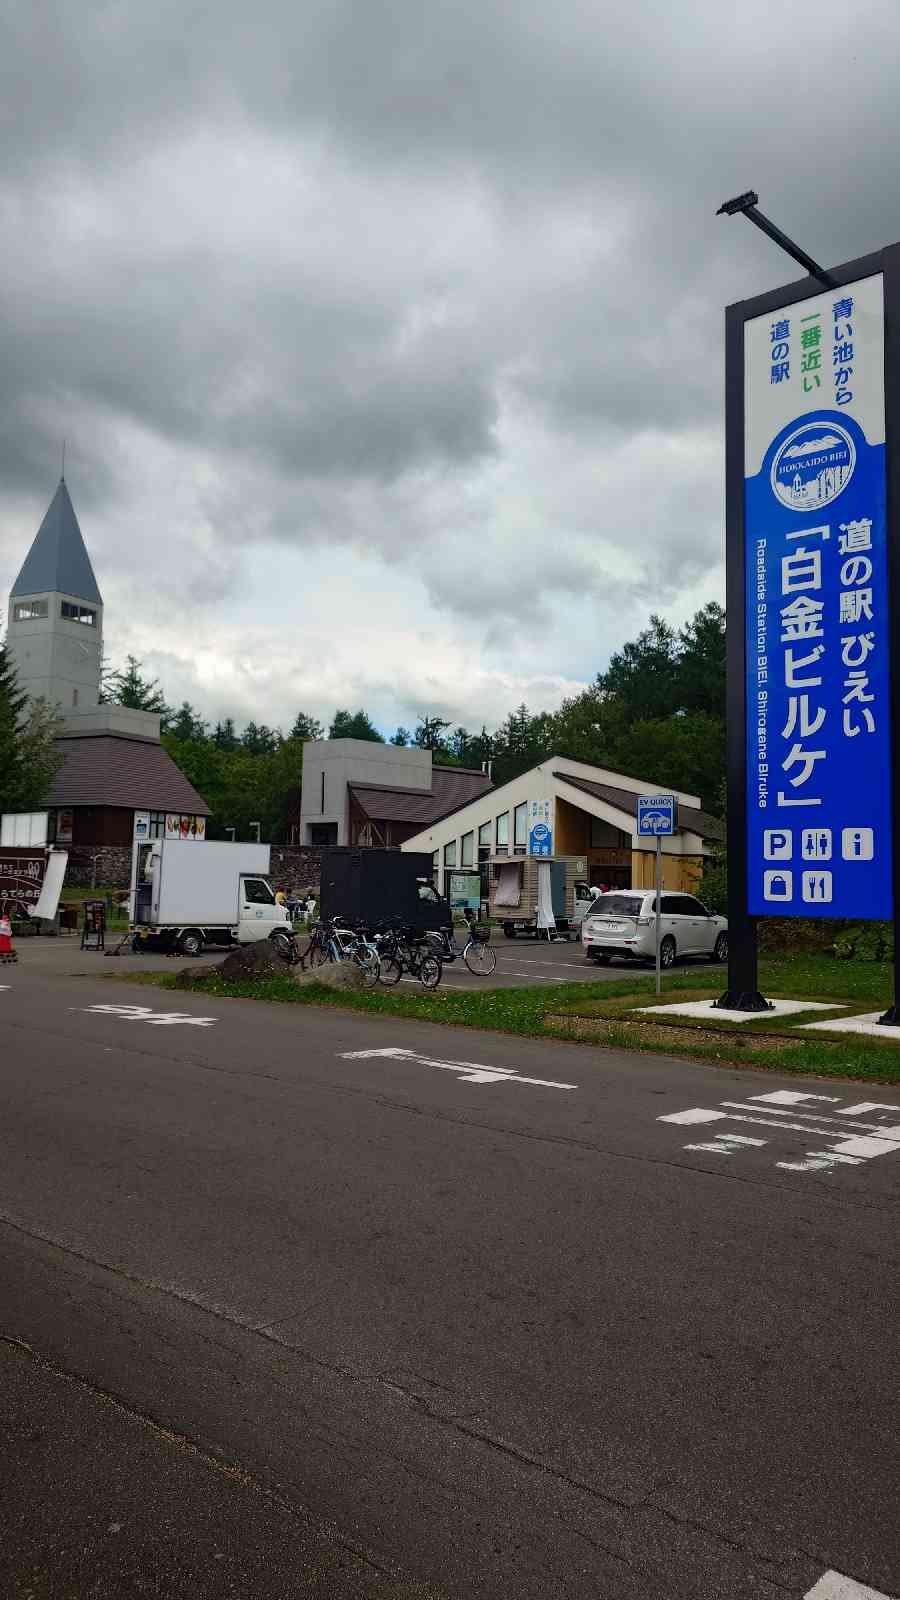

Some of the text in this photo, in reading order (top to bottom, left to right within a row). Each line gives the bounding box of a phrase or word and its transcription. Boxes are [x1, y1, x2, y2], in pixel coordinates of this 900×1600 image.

[769, 319, 791, 385] 道の駅
[800, 313, 821, 393] 一番近い
[831, 296, 854, 406] 青い池から
[779, 450, 848, 474] HOKKAIDO BIEI
[757, 538, 767, 600] Roadside
[757, 603, 767, 653] Station
[838, 517, 876, 737] 道の駅 びえい
[777, 523, 831, 807] 「白金ビルケ」
[757, 690, 768, 760] Shirogane
[650, 799, 672, 807] QUICK
[758, 763, 769, 808] Biruke
[770, 833, 787, 855] P
